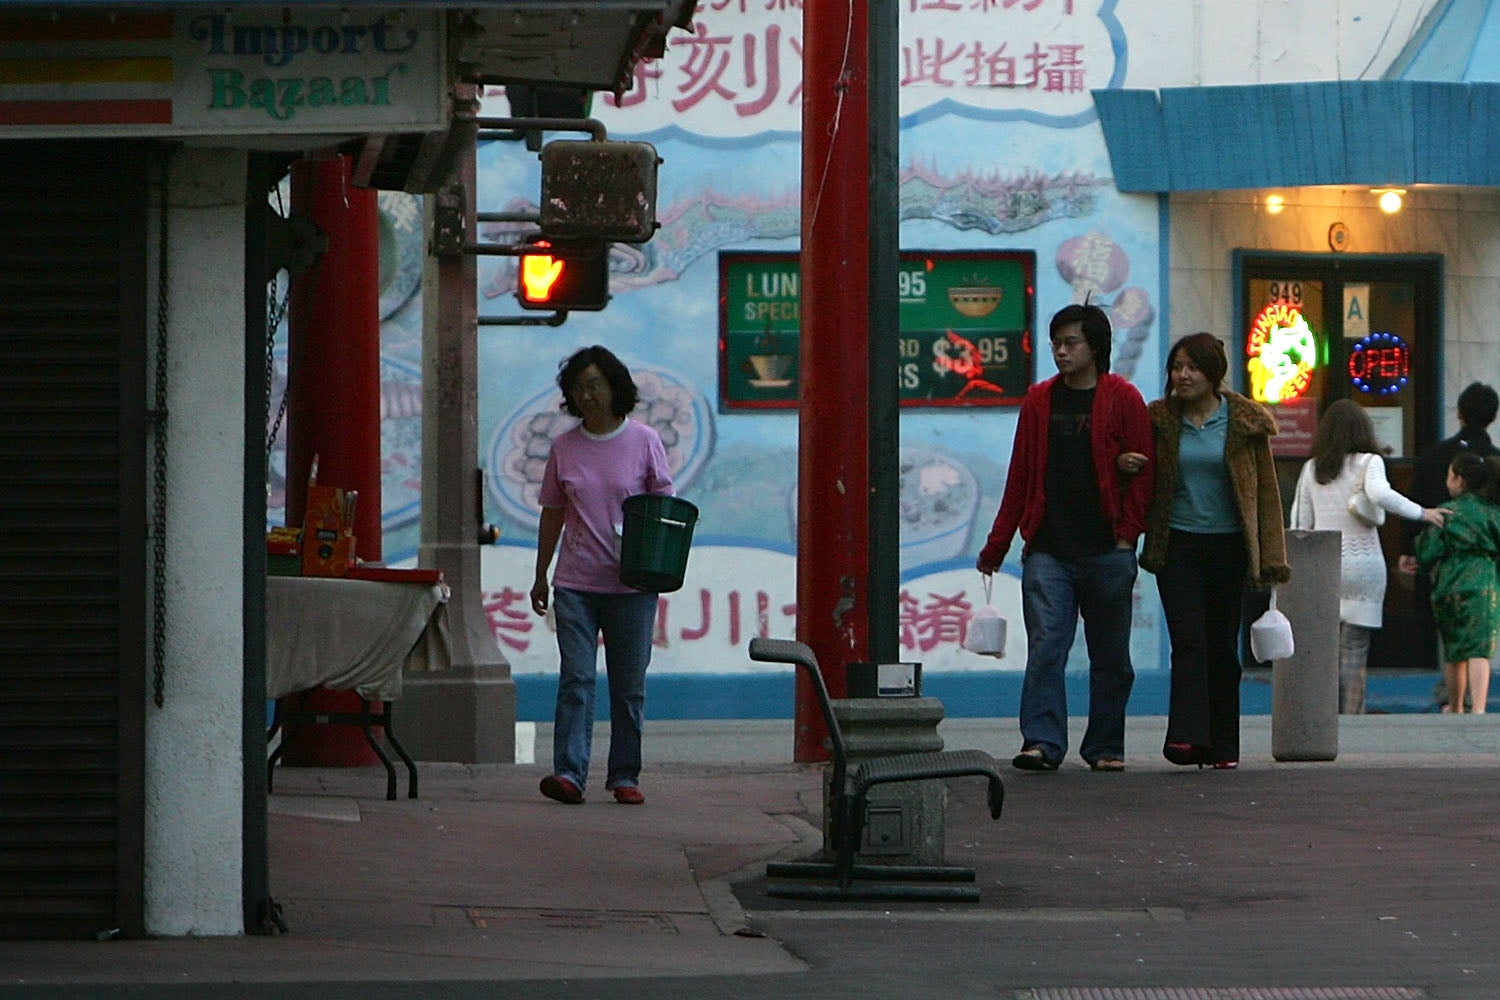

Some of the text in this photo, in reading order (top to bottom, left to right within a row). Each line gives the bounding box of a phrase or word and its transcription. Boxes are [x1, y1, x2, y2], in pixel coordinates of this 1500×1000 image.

[190, 12, 419, 66] Import
[207, 62, 411, 121] Bazaar
[1269, 282, 1303, 304] 949
[1347, 296, 1364, 320] A
[1249, 303, 1300, 354] TSINGTAO
[1349, 347, 1409, 379] OPEN
